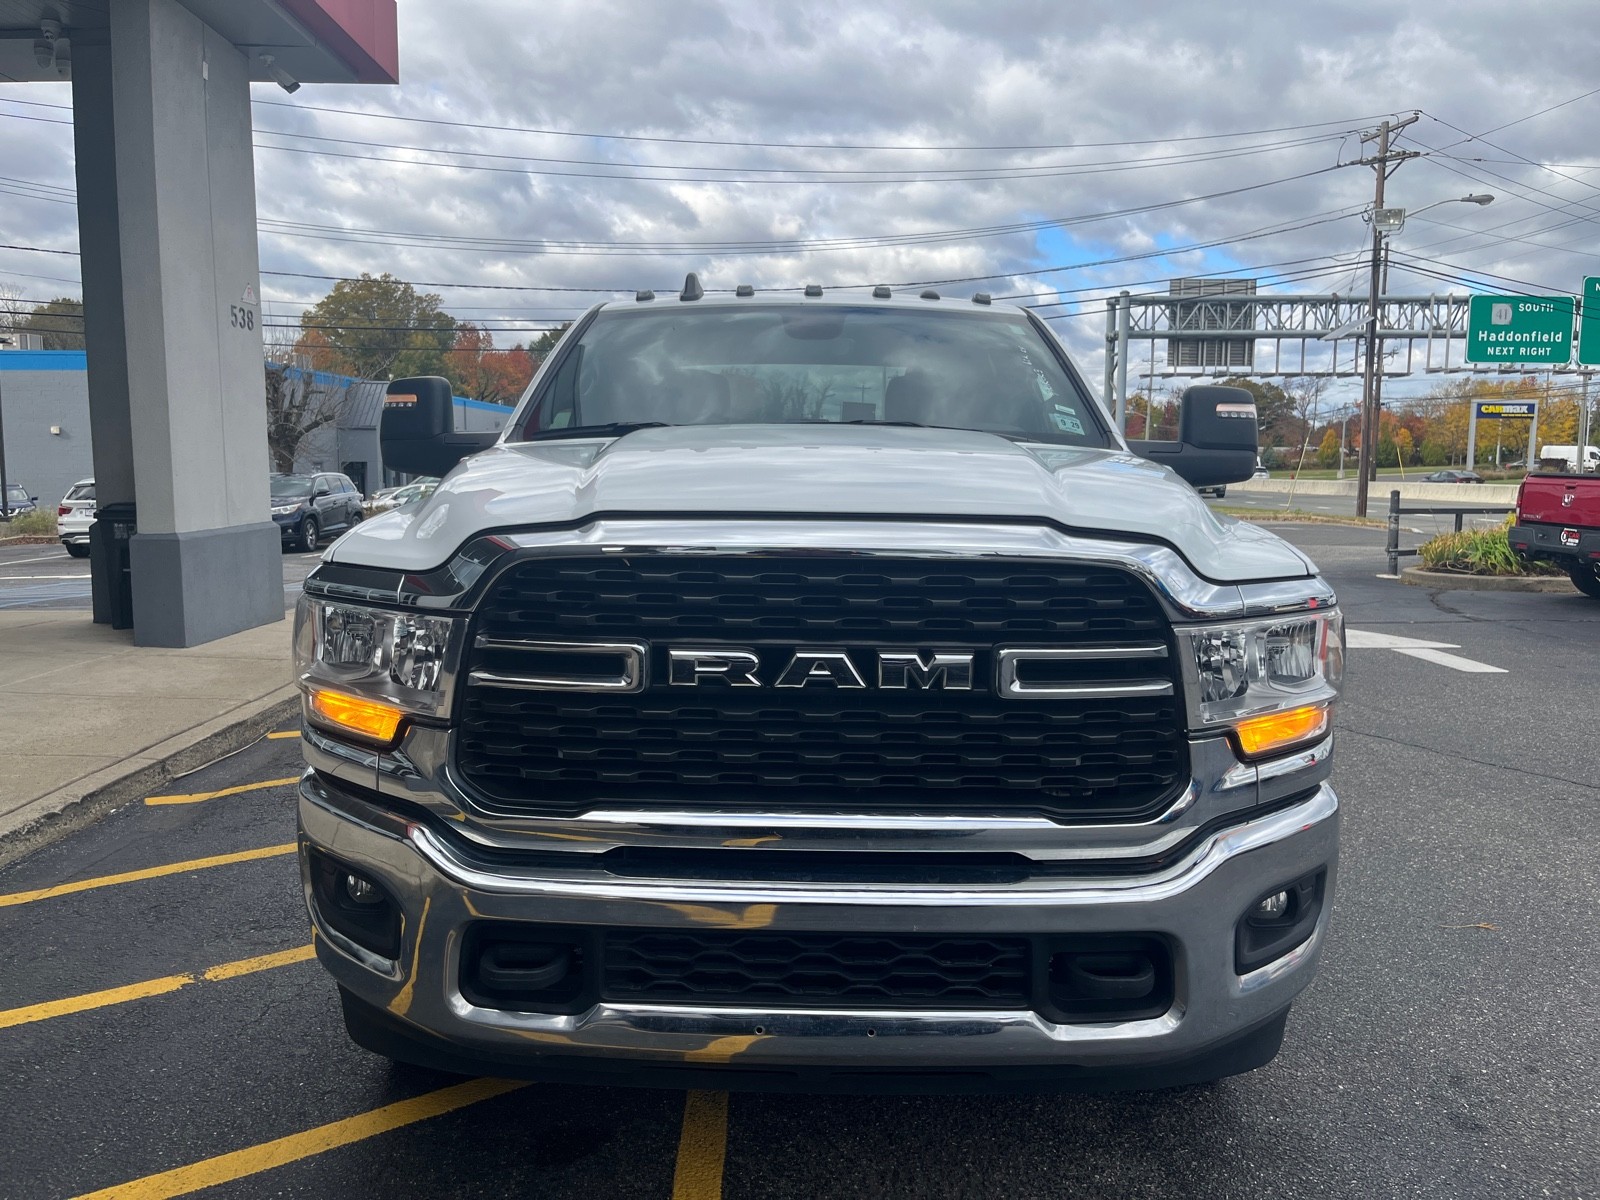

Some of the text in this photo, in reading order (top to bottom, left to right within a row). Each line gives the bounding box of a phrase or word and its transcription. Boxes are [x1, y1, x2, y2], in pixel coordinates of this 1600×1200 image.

[1496, 308, 1508, 320] 41
[1518, 303, 1554, 313] SOUTH
[230, 304, 254, 331] 538
[1478, 330, 1562, 343] Haddonfield
[1487, 347, 1552, 356] NEXT RIGHT
[669, 650, 974, 690] RAM
